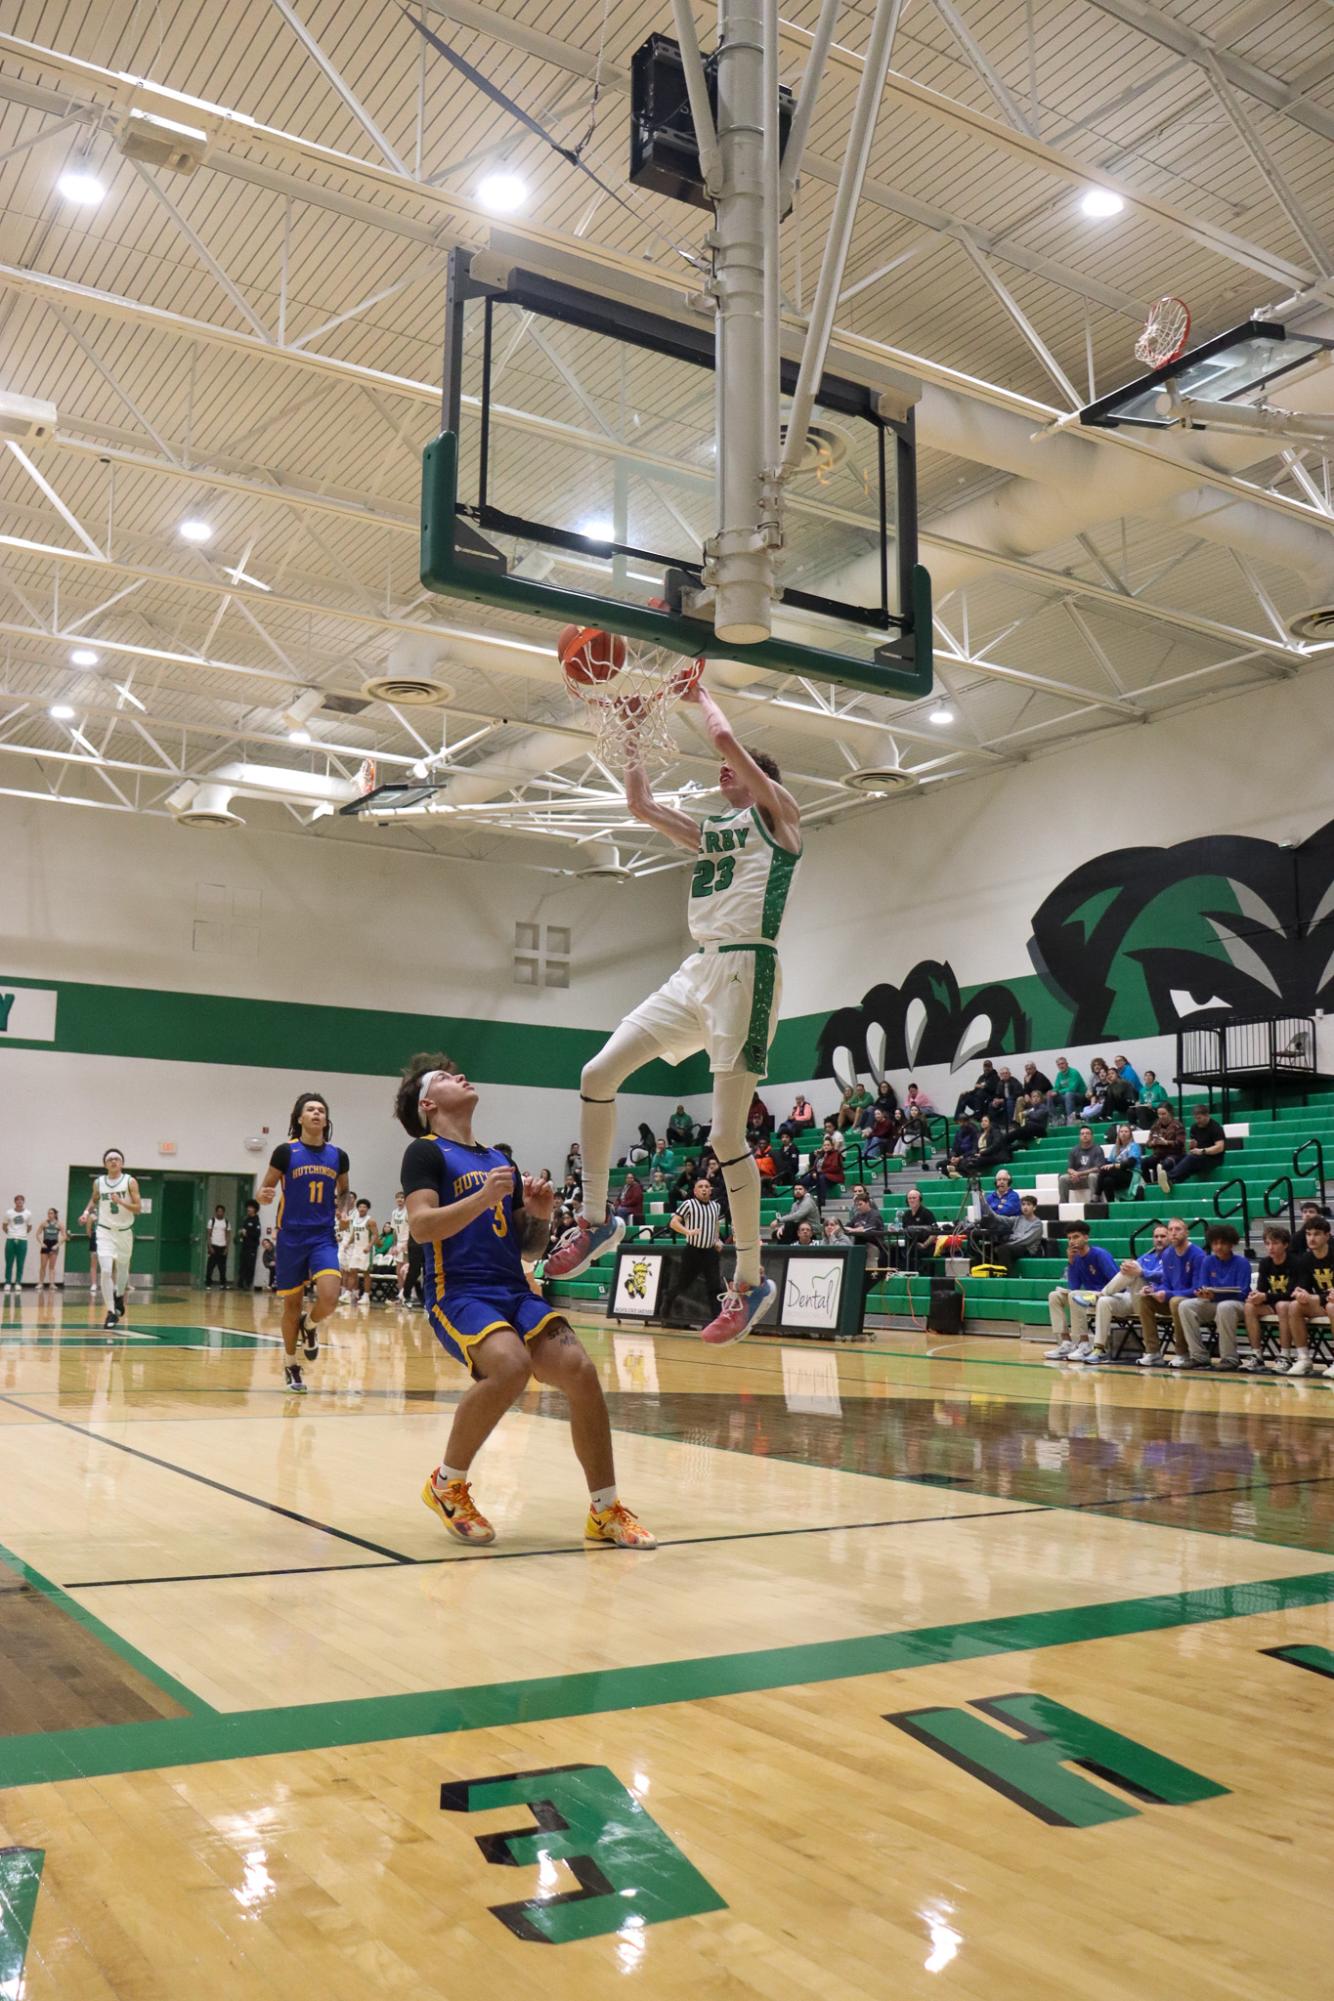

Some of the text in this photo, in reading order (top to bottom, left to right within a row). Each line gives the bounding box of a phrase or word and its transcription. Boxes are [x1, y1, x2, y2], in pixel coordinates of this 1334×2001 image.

[698, 827, 749, 854] RBY
[692, 855, 736, 898] 23
[309, 1181, 324, 1204] 11
[787, 1279, 833, 1315] Dental
